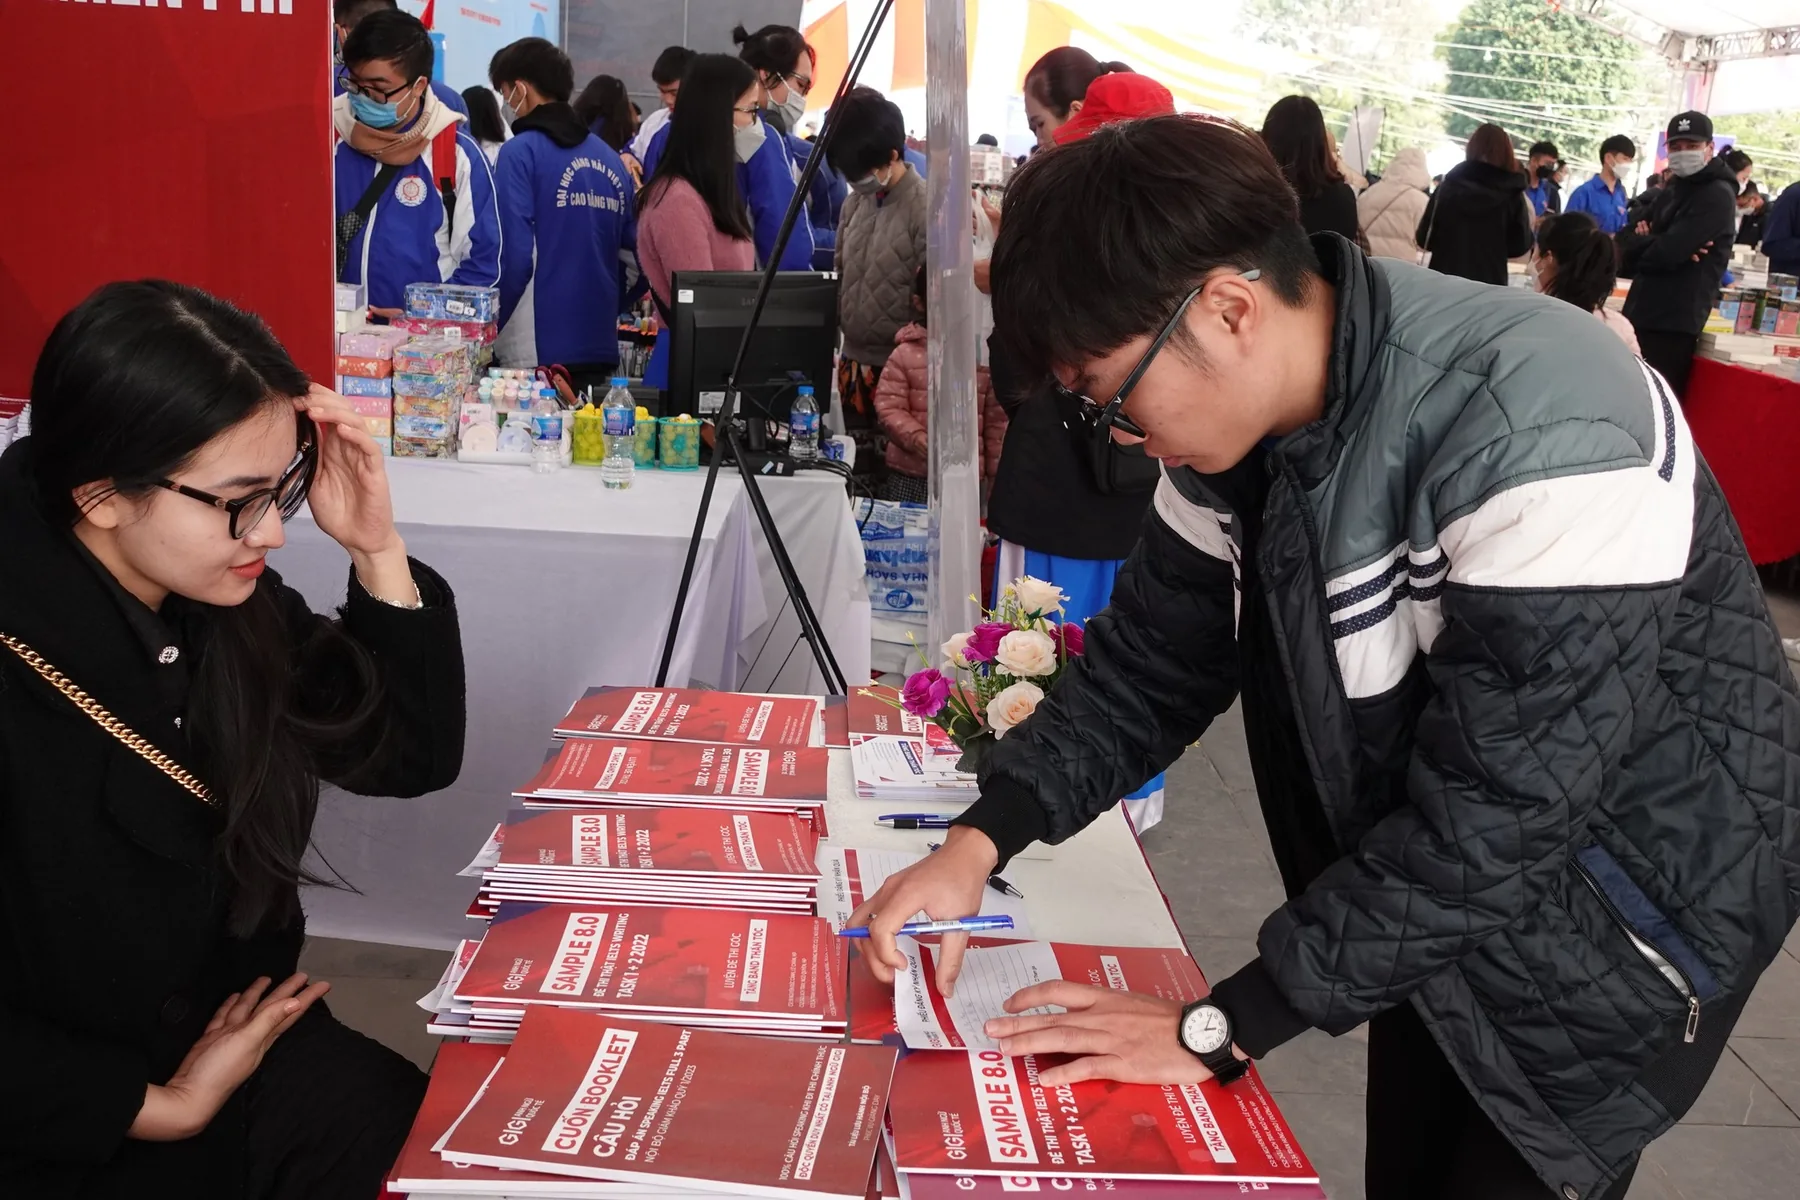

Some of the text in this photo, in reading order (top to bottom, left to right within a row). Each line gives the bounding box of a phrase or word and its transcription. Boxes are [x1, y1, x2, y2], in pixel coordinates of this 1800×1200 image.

[571, 157, 590, 171] HÀNG
[560, 167, 574, 188] HỌC
[557, 189, 568, 207] ĐẠI
[570, 193, 586, 206] CAO
[620, 694, 656, 731] SAMPLE 8.0
[701, 748, 715, 763] TASK
[740, 752, 761, 785] SAMPLE
[580, 818, 602, 865] SAMPLE 8.0
[616, 814, 627, 849] IELTS WRITING
[636, 830, 650, 846] 2022
[552, 916, 600, 991] SAMPLE 8.0
[594, 914, 629, 997] ĐỀ THI THẬT IELTS WRITING
[724, 933, 741, 988] LUYỆN ĐỀ THI GỐC
[745, 928, 763, 994] TĂNG BAND THẦN TỐC
[908, 955, 917, 969] QUÀ
[616, 978, 637, 998] TASK
[630, 934, 649, 956] 2022
[502, 974, 526, 990] GIGI
[911, 969, 919, 985] NHẬN
[915, 994, 925, 1009] ĐĂNG
[919, 1010, 928, 1022] PHIẾU
[676, 1030, 691, 1050] PART
[816, 1046, 827, 1060] THỨC
[666, 1058, 681, 1076] FULL
[811, 1061, 822, 1081] CHÍNH
[979, 1050, 1007, 1078] 8.0
[1022, 1054, 1042, 1086] WRITIN
[554, 1034, 633, 1150] CUỐN BOOKLET
[657, 1077, 673, 1095] IELTS
[808, 1082, 817, 1091] THI
[1053, 1084, 1075, 1104] 202
[803, 1100, 812, 1110] KHI
[1031, 1088, 1047, 1110] IELTS
[1164, 1092, 1178, 1104] THI
[641, 1096, 664, 1128] SPEAKING
[645, 1065, 696, 1163] NỘI BỘ GIÁM KHẢO QUÝ 1/2023
[799, 1050, 842, 1178] ĐỘC QUYỀN DUY NHẤT CÓ TẠI ANH NGŨ GIGI
[985, 1084, 1028, 1158] SAMPLE
[1169, 1106, 1184, 1116] ĐỀ
[1196, 1107, 1214, 1128] BAND
[498, 1116, 532, 1146] GIGI
[593, 1096, 642, 1157] CÂU HỎI
[794, 1111, 808, 1137] SPEAKING
[1038, 1111, 1055, 1134] THẬT
[1176, 1118, 1196, 1143] LUYỆN
[636, 1129, 647, 1141] ÁN
[790, 1138, 799, 1148] HỎI
[1045, 1135, 1060, 1150] THI
[1207, 1131, 1226, 1151] TĂNG
[626, 1142, 640, 1160] ĐÁP
[785, 1149, 796, 1163] CÂU
[943, 1134, 968, 1160] GIGI
[1070, 1134, 1095, 1165] TASK
[1048, 1152, 1064, 1164] ĐỀ
[779, 1164, 791, 1180] 100%
